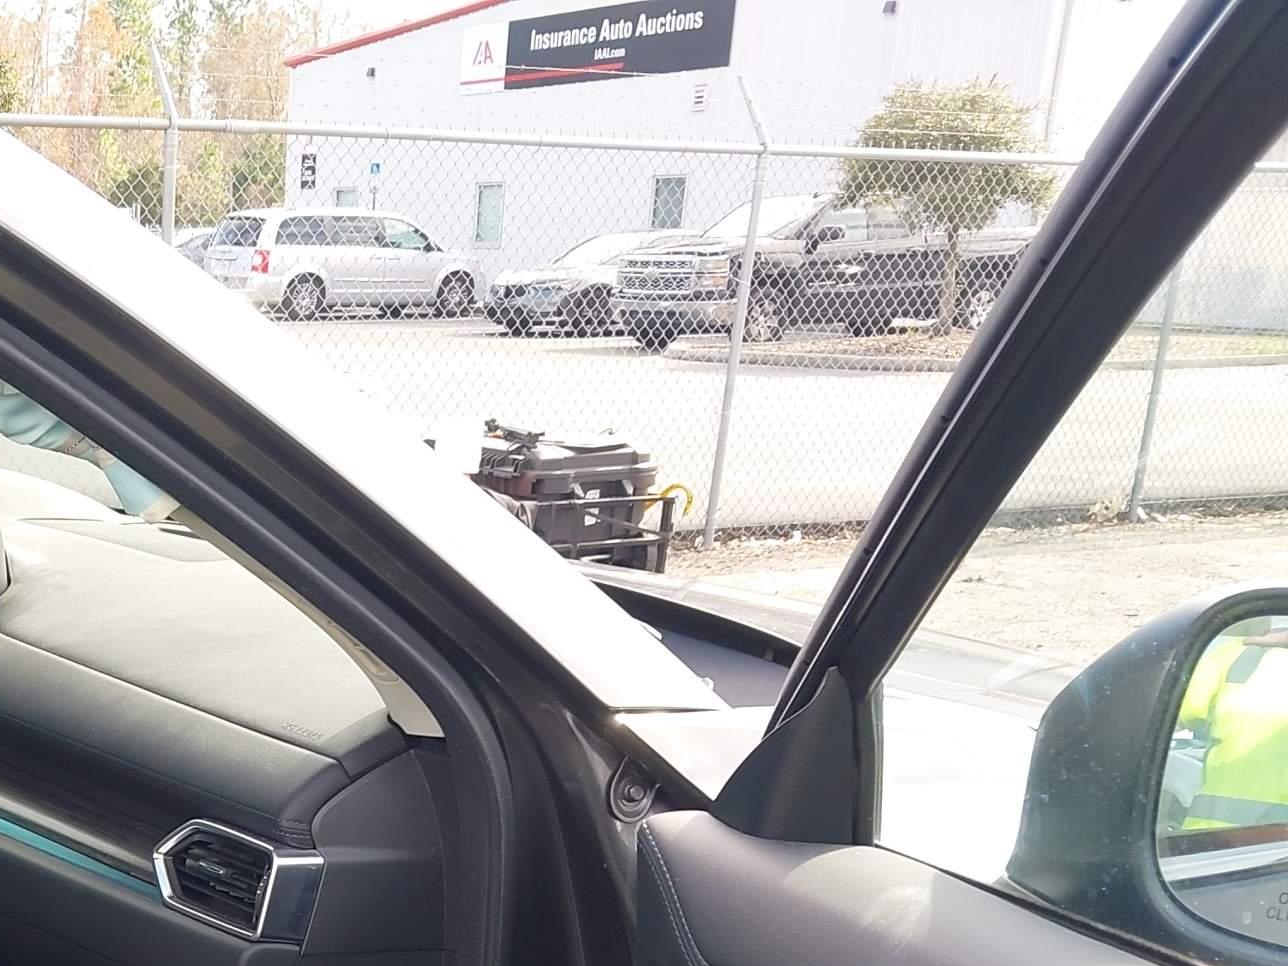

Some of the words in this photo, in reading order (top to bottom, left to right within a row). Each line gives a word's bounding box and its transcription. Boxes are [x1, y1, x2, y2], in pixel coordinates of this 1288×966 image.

[530, 28, 597, 51] Insurance
[599, 18, 633, 42] Auto
[635, 9, 704, 37] Auctions
